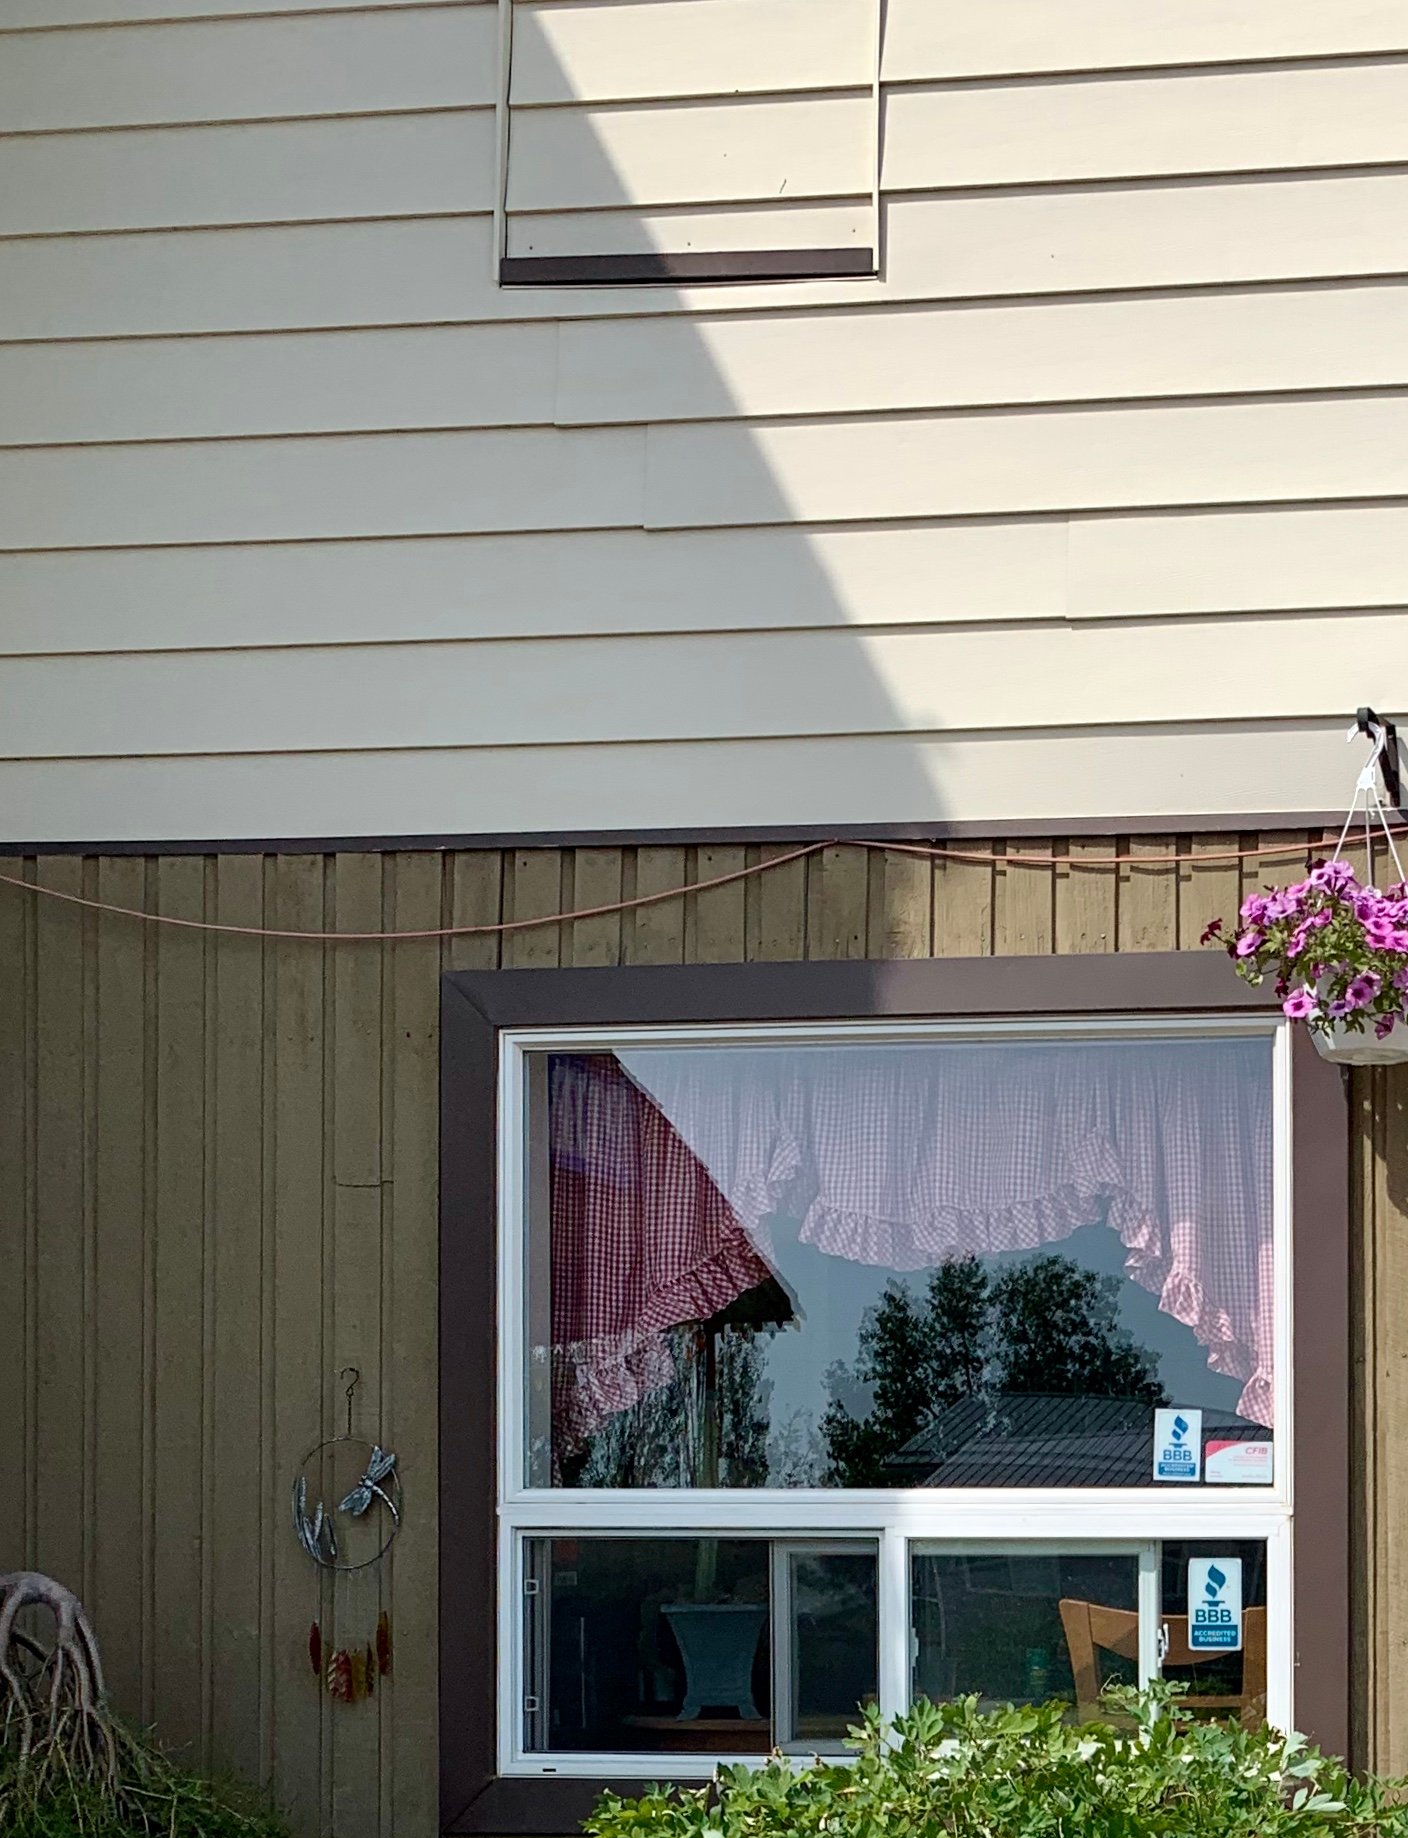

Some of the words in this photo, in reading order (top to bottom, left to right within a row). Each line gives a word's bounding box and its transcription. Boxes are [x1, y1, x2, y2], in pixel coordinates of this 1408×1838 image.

[1163, 1449, 1193, 1461] BBB
[1245, 1446, 1268, 1455] CFIB
[1195, 1608, 1232, 1623] BBB
